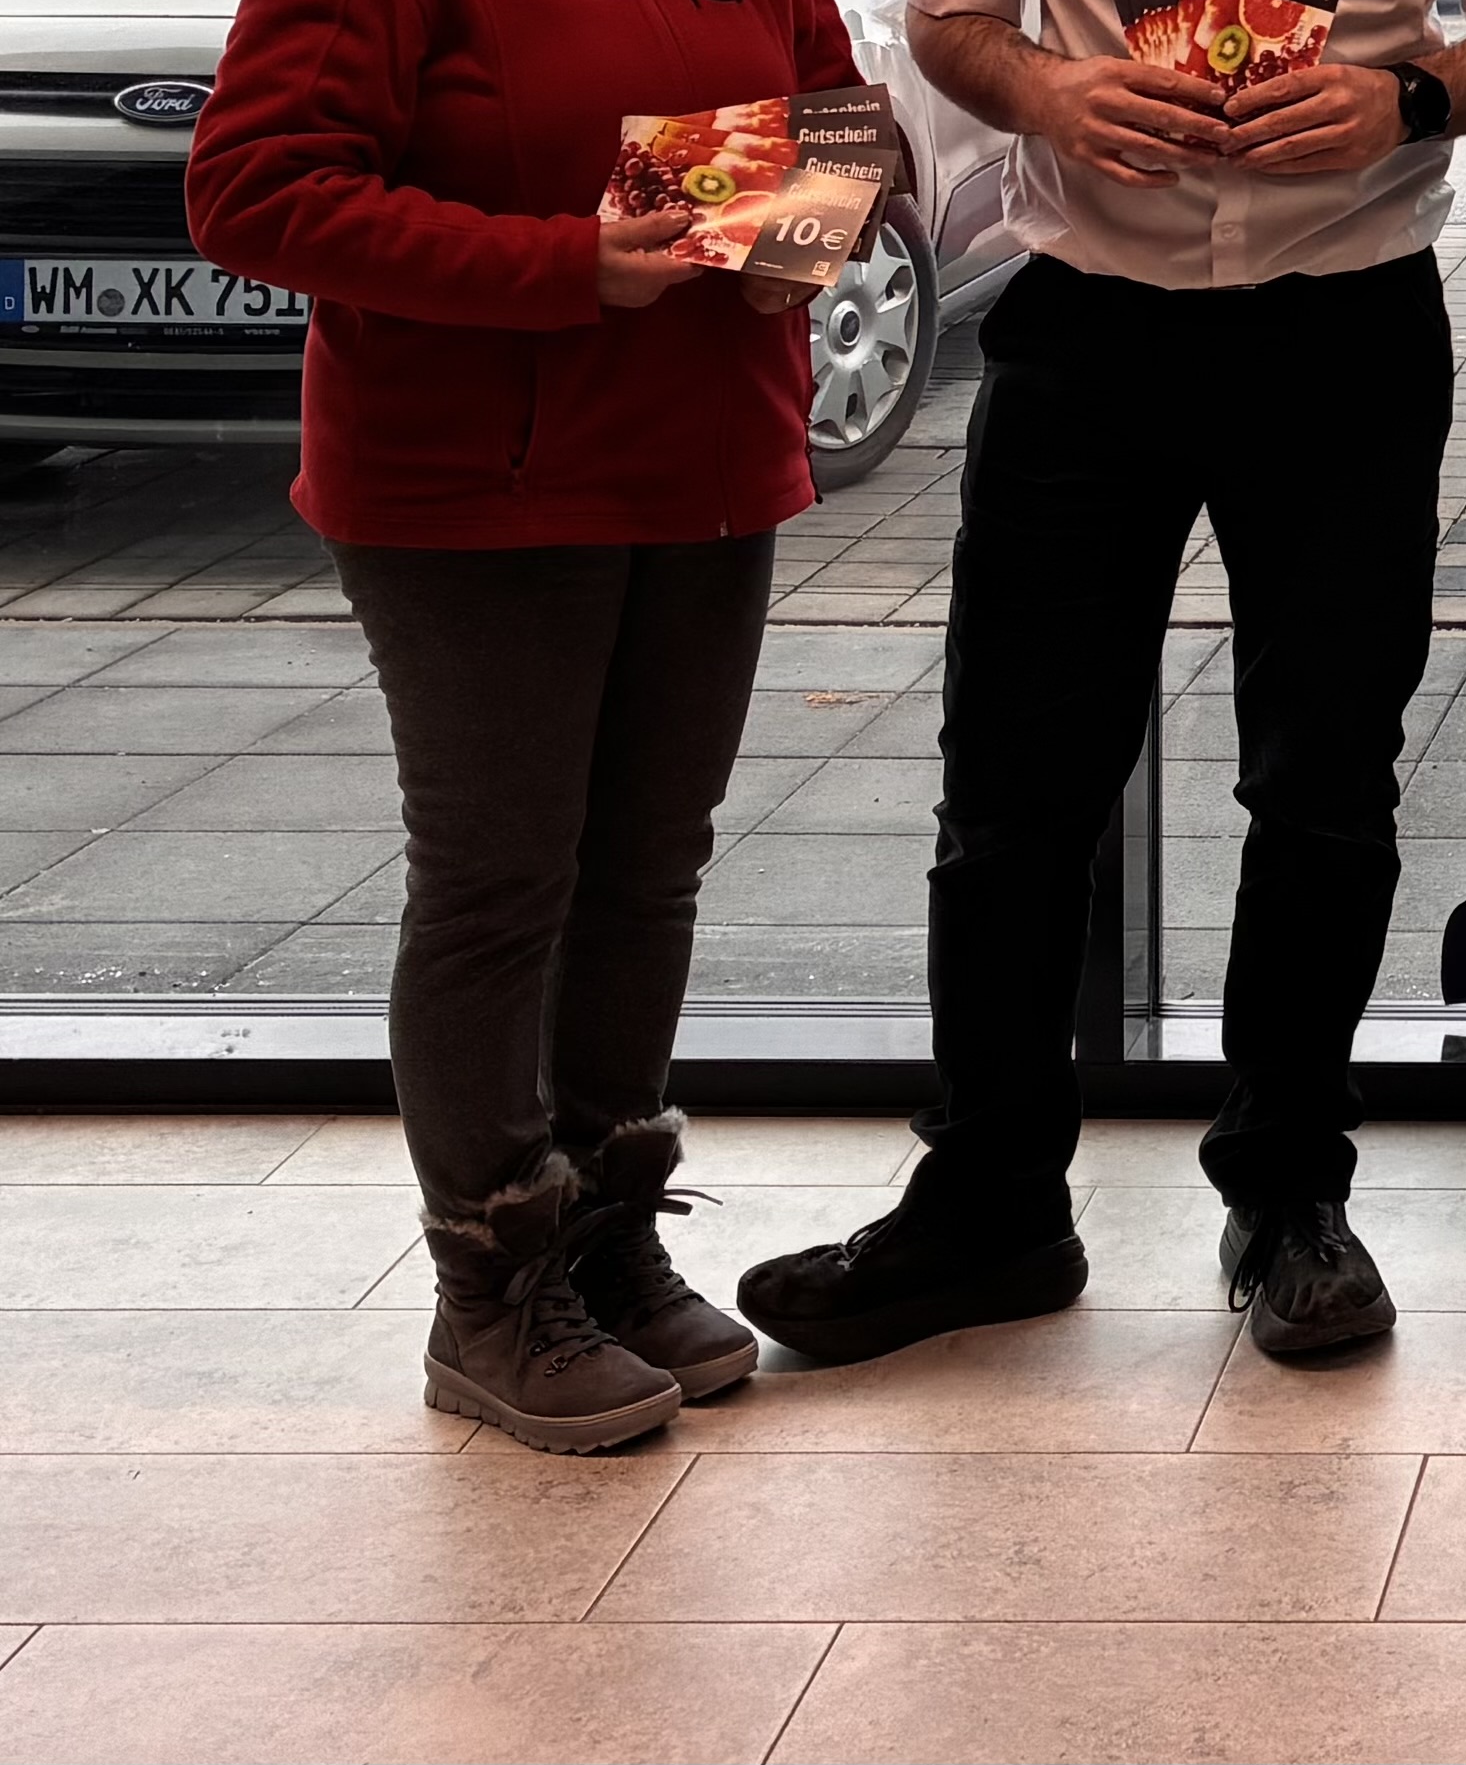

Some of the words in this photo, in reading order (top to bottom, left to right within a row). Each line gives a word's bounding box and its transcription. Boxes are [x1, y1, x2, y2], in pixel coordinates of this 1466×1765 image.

[135, 87, 195, 111] Ford
[798, 126, 877, 145] Gutschein
[806, 157, 883, 181] Gutschein
[775, 215, 848, 250] 10€
[28, 266, 94, 315] WM
[131, 267, 195, 316] XK
[5, 297, 15, 310] D
